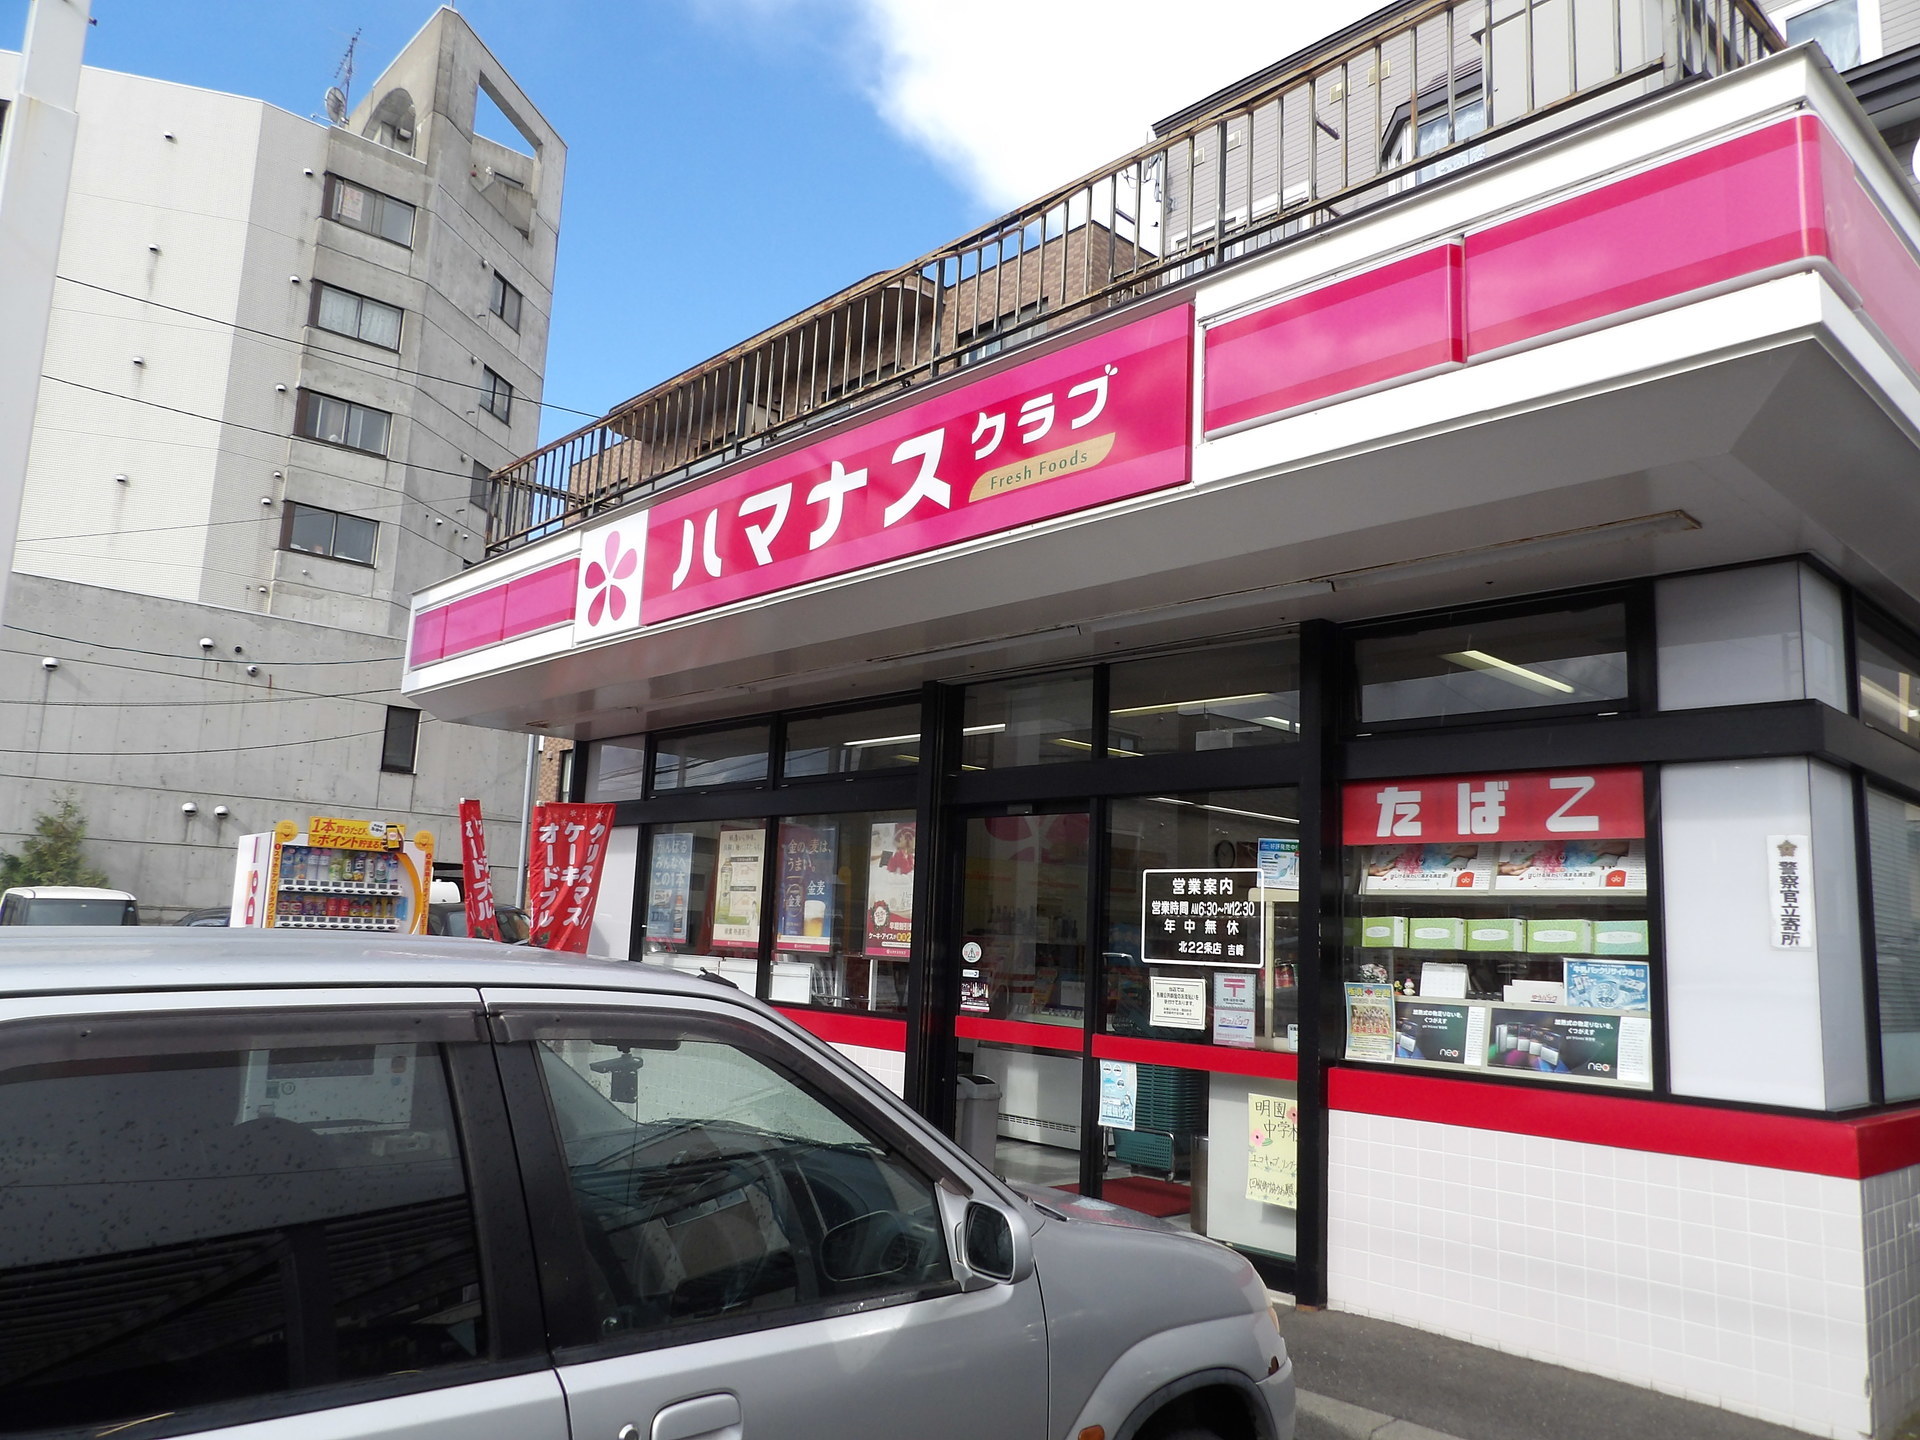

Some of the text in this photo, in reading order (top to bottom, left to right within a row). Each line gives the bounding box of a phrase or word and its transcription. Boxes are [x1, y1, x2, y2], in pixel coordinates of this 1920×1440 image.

[671, 364, 1118, 590] ハマナス クラブ
[990, 450, 1089, 491] Fresh Foods
[1376, 776, 1600, 838] たばこ
[561, 822, 585, 887] ケーキ
[539, 822, 559, 928] オードブル
[563, 822, 606, 926] クリスマス
[807, 880, 825, 895] 金麦
[1172, 877, 1234, 895] 営業案内
[1151, 900, 1189, 915] 営業時間
[1778, 861, 1801, 946] 警察官立寄所
[1164, 919, 1240, 936] 年中無休
[1178, 941, 1222, 955] 北22条店
[1439, 1048, 1459, 1057] neo
[1587, 1062, 1610, 1072] neo
[1255, 1099, 1287, 1119] 明園
